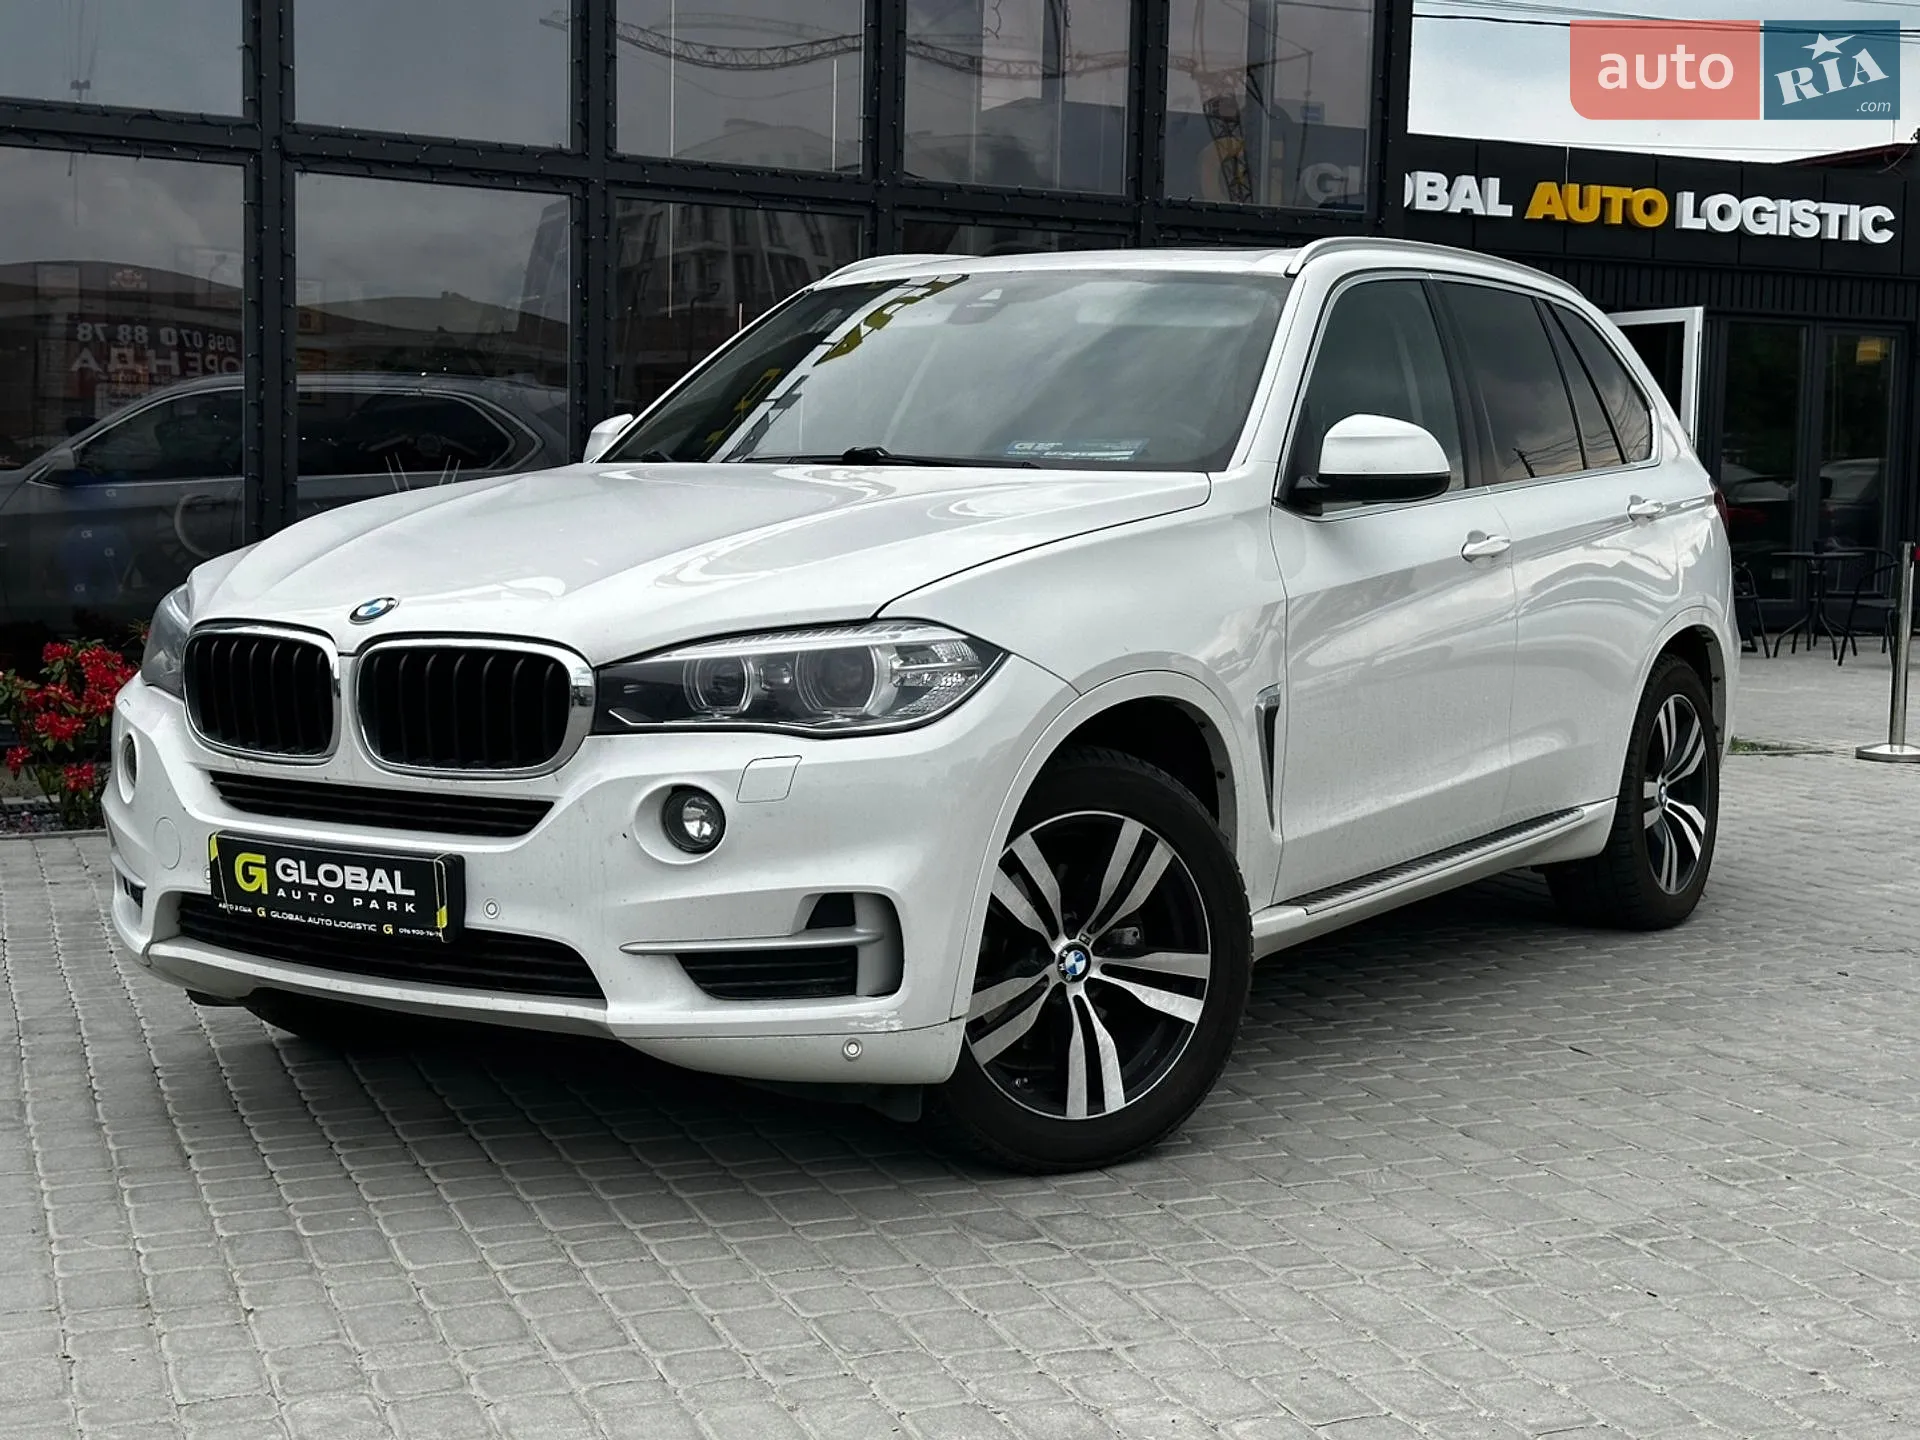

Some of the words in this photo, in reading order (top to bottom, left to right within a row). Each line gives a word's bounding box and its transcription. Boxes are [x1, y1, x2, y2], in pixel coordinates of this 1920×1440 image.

[1403, 170, 1513, 218] BAL
[1524, 181, 1668, 229] AUTO
[1675, 190, 1896, 244] LOGISTIC
[234, 852, 268, 895] G
[275, 857, 416, 896] GLOBAL
[277, 888, 335, 904] AUTO
[353, 897, 416, 913] PARK
[270, 910, 306, 923] GLOBAL
[307, 916, 332, 927] AUTO
[333, 920, 377, 932] LOGISTIC
